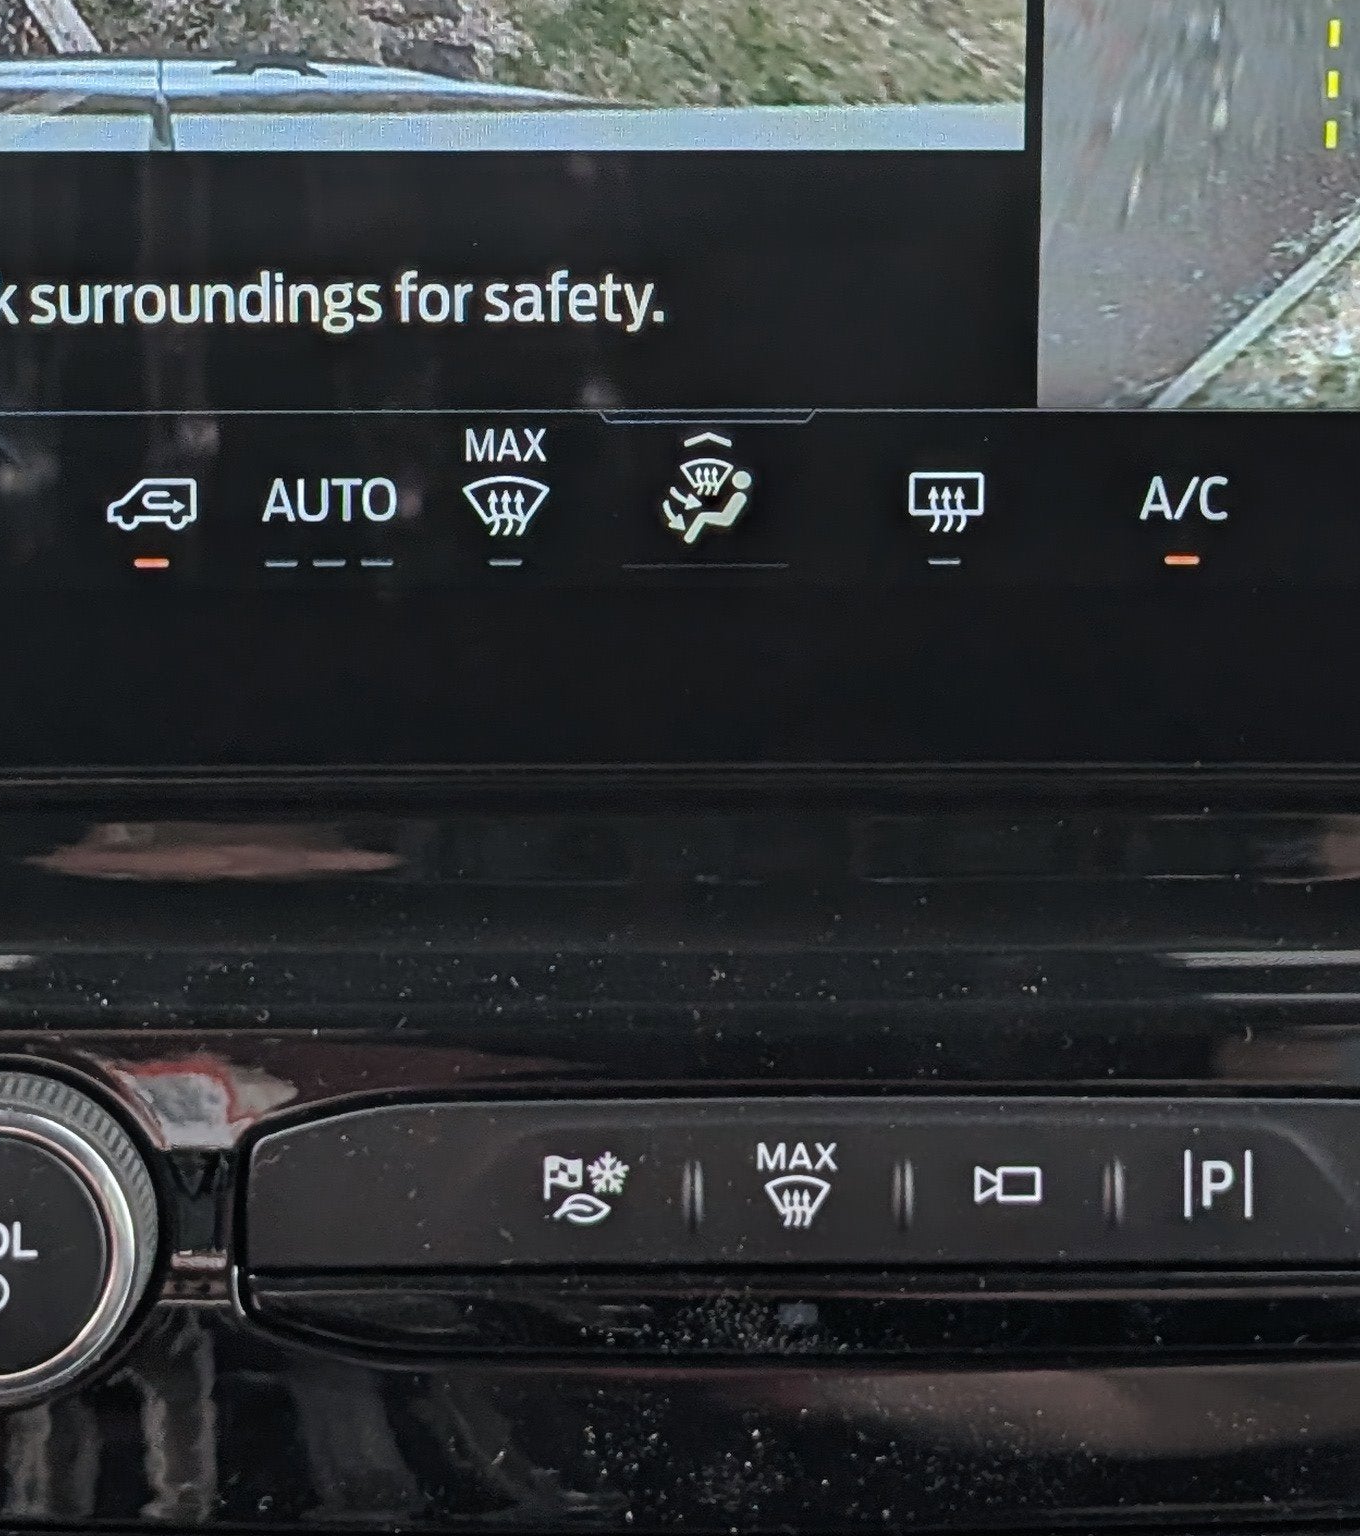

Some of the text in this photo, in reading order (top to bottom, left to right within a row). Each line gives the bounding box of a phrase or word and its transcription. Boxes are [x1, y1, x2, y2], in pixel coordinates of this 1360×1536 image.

[27, 268, 384, 335] surroundings
[393, 268, 475, 325] for
[483, 268, 666, 334] safety.
[464, 427, 548, 464] MAX
[260, 475, 400, 525] AUTO
[1138, 474, 1230, 523] A/C
[755, 1140, 839, 1173] MAX
